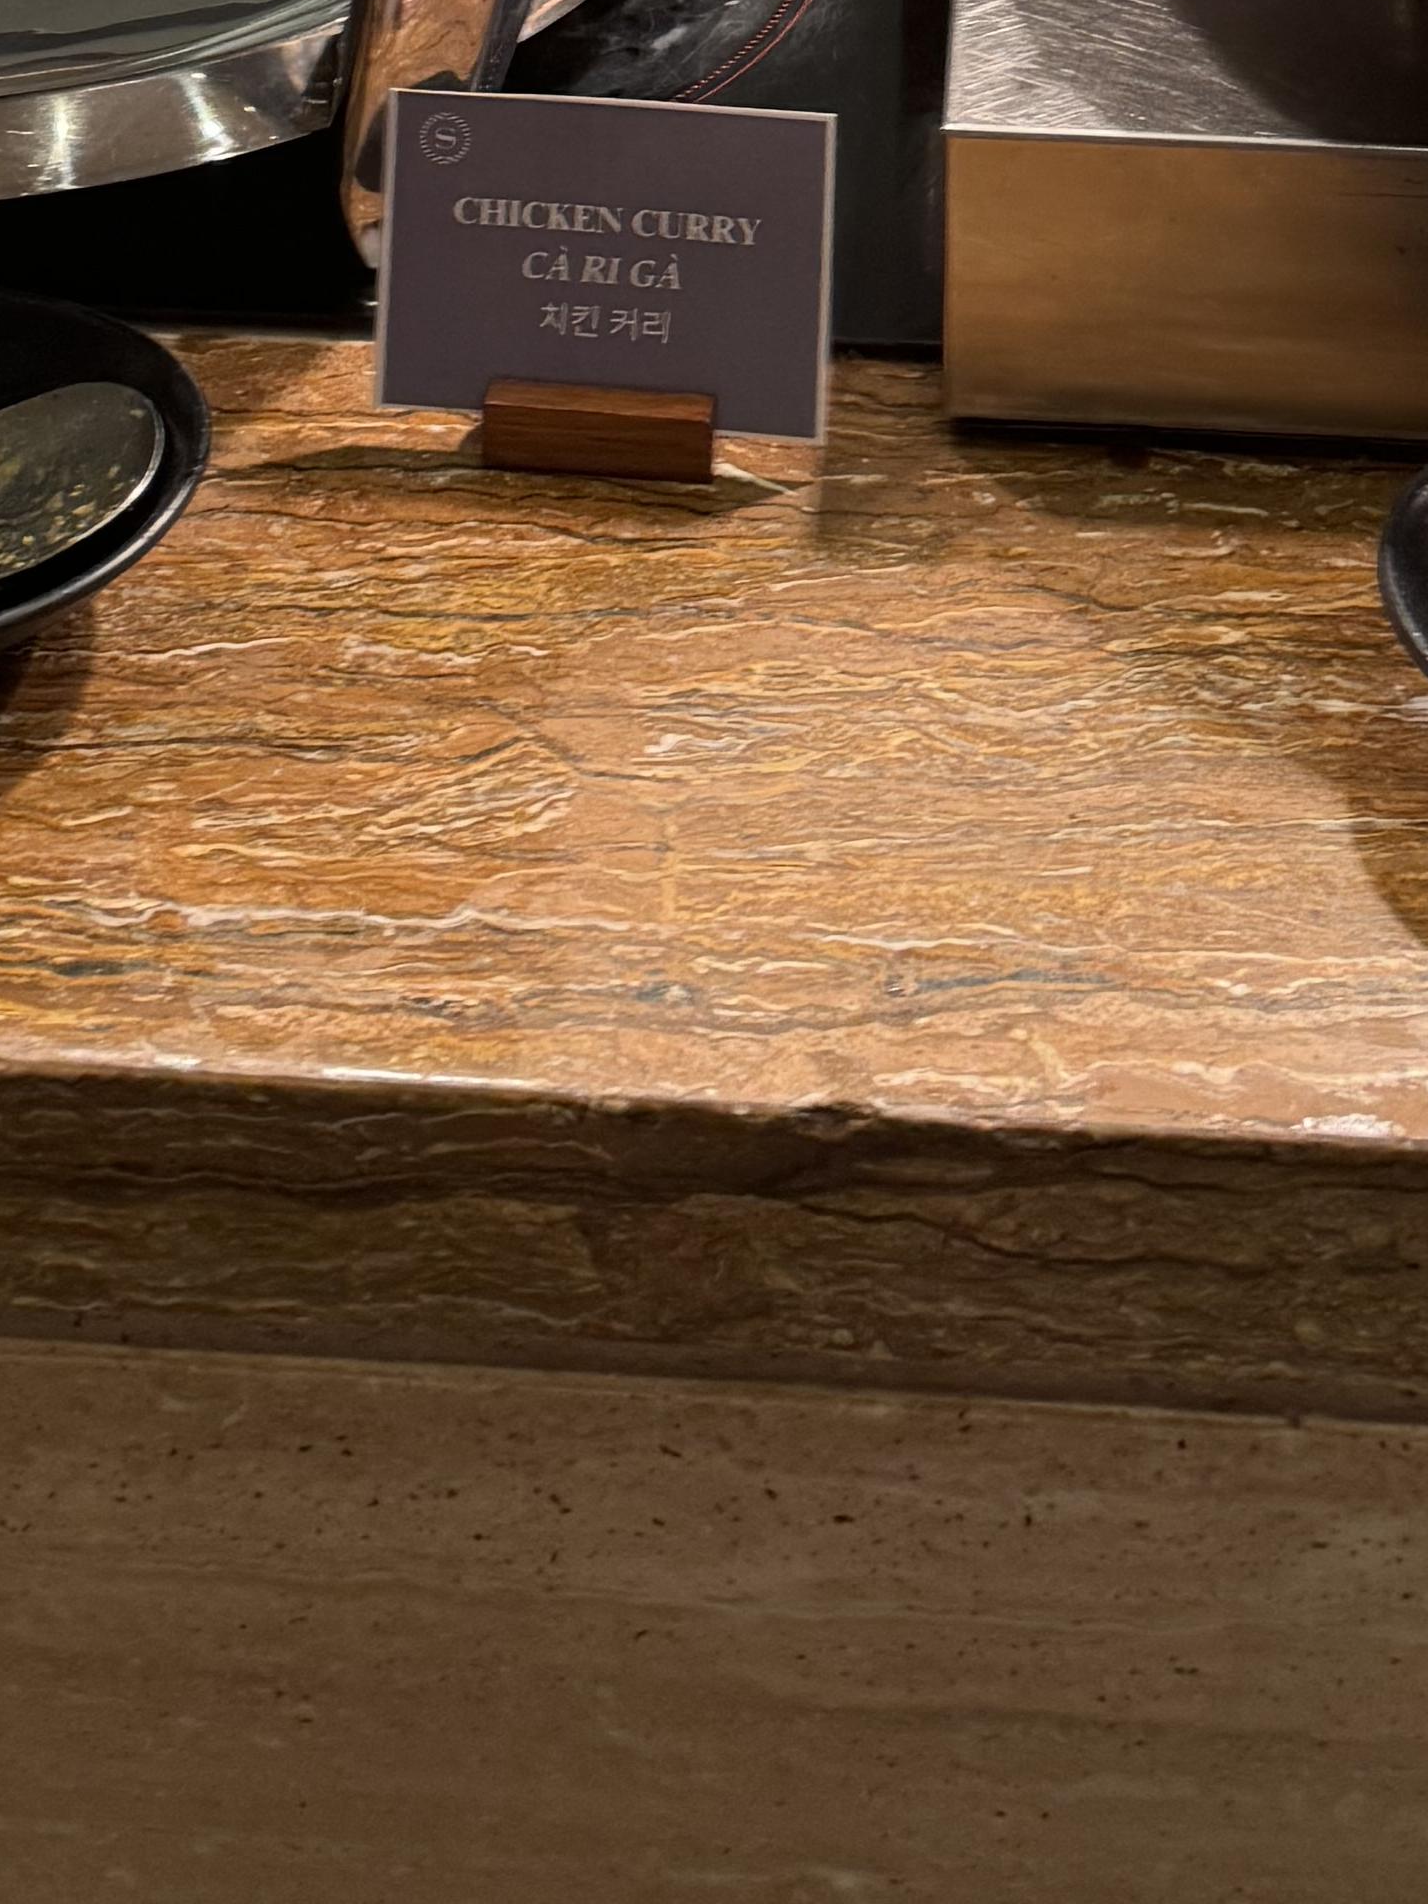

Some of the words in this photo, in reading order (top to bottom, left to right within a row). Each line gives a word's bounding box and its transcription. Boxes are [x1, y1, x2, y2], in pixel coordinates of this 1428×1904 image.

[452, 195, 623, 235] CHICKEN
[631, 208, 762, 246] CURRY
[521, 245, 570, 282] CÀ
[580, 254, 622, 285] RI
[630, 252, 683, 290] GÀ
[539, 301, 600, 339] 치킨
[609, 308, 672, 344] 커리
